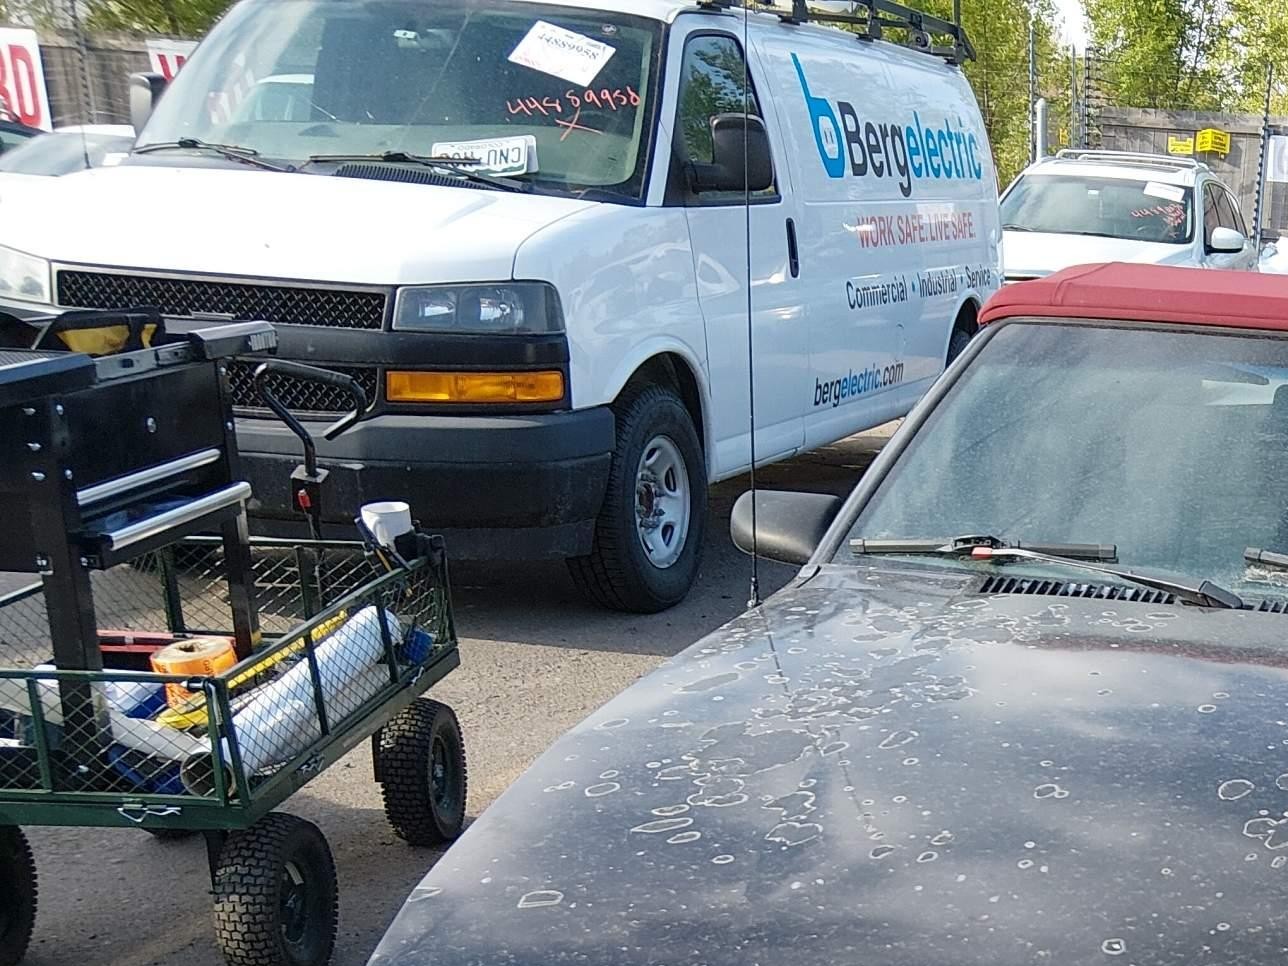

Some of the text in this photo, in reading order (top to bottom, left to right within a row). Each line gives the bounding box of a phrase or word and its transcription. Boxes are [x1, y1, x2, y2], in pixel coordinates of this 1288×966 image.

[487, 147, 521, 166] CNU
[837, 101, 982, 198] Bergelectric
[857, 212, 976, 248] WORK SAFE. LIVE SAFE.
[846, 264, 991, 309] Commercial Industrial Service
[814, 360, 904, 407] bergelectric.com
